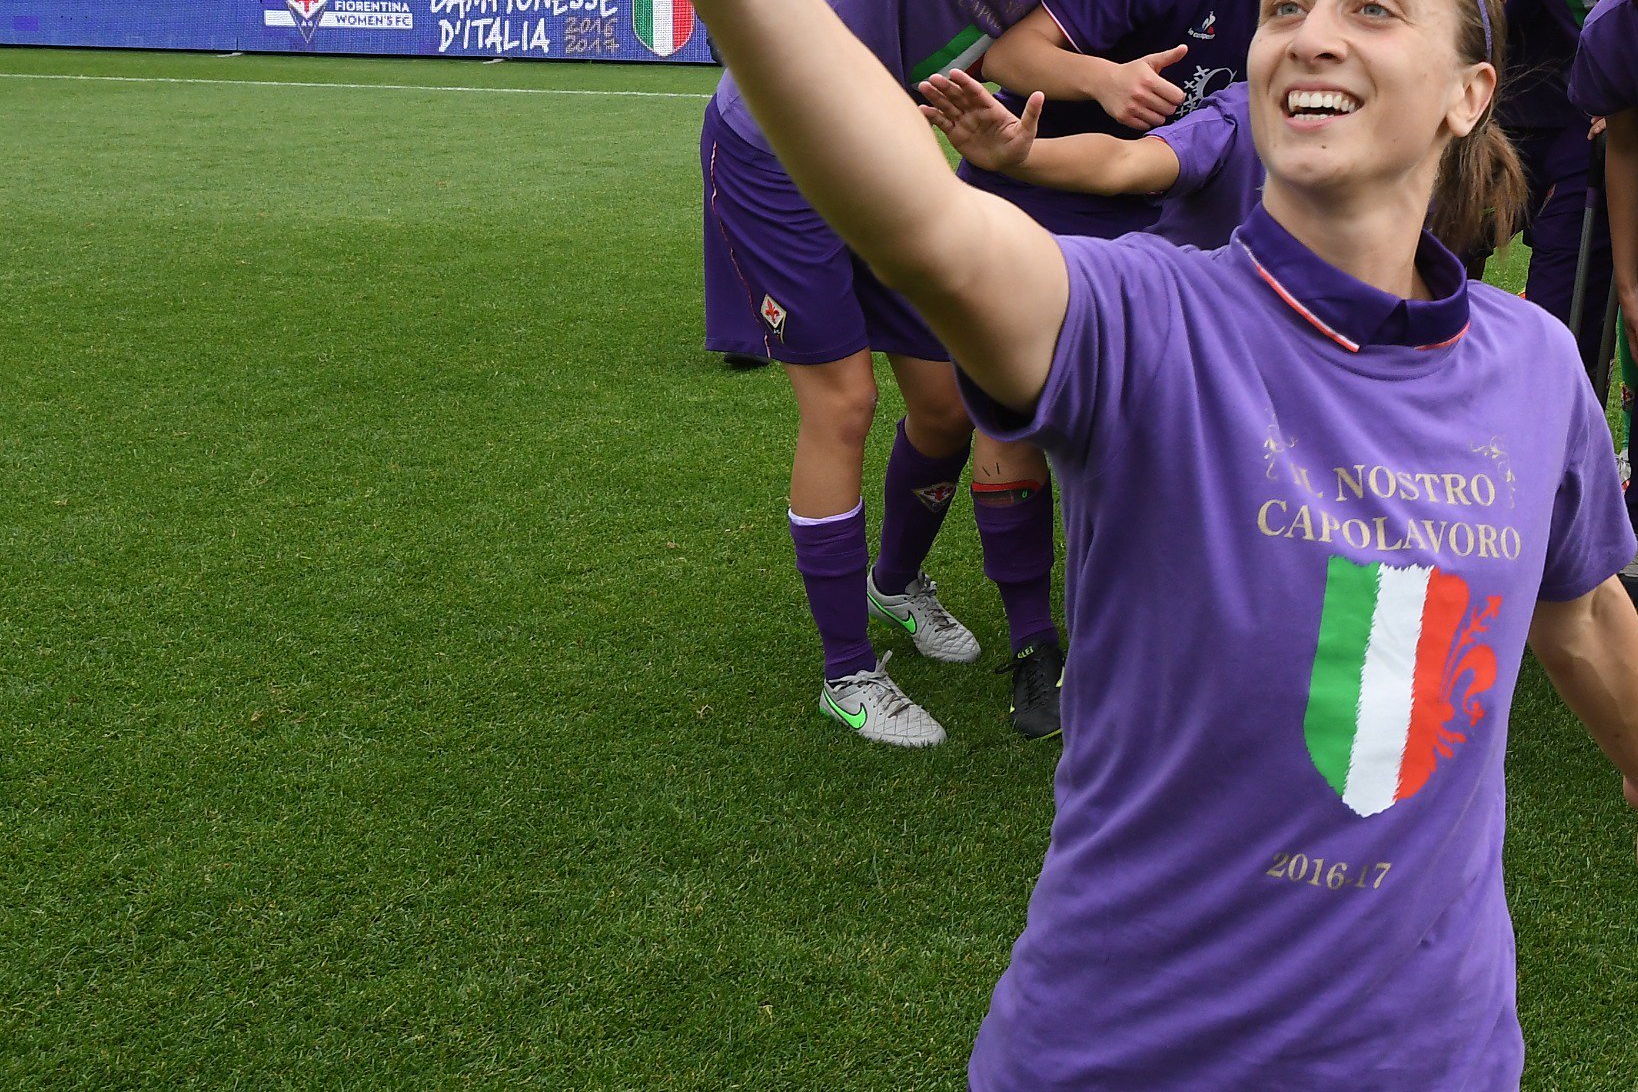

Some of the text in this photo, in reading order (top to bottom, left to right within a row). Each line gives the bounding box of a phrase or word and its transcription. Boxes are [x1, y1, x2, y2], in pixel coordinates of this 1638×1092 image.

[334, 0, 410, 13] FIORENTINA
[335, 14, 412, 27] WOMEN'S FC
[438, 16, 551, 54] D'ITALIA
[564, 16, 619, 35] 2016
[1289, 462, 1496, 507] IL NOSTRO
[1256, 498, 1522, 560] CAPOLAVORO
